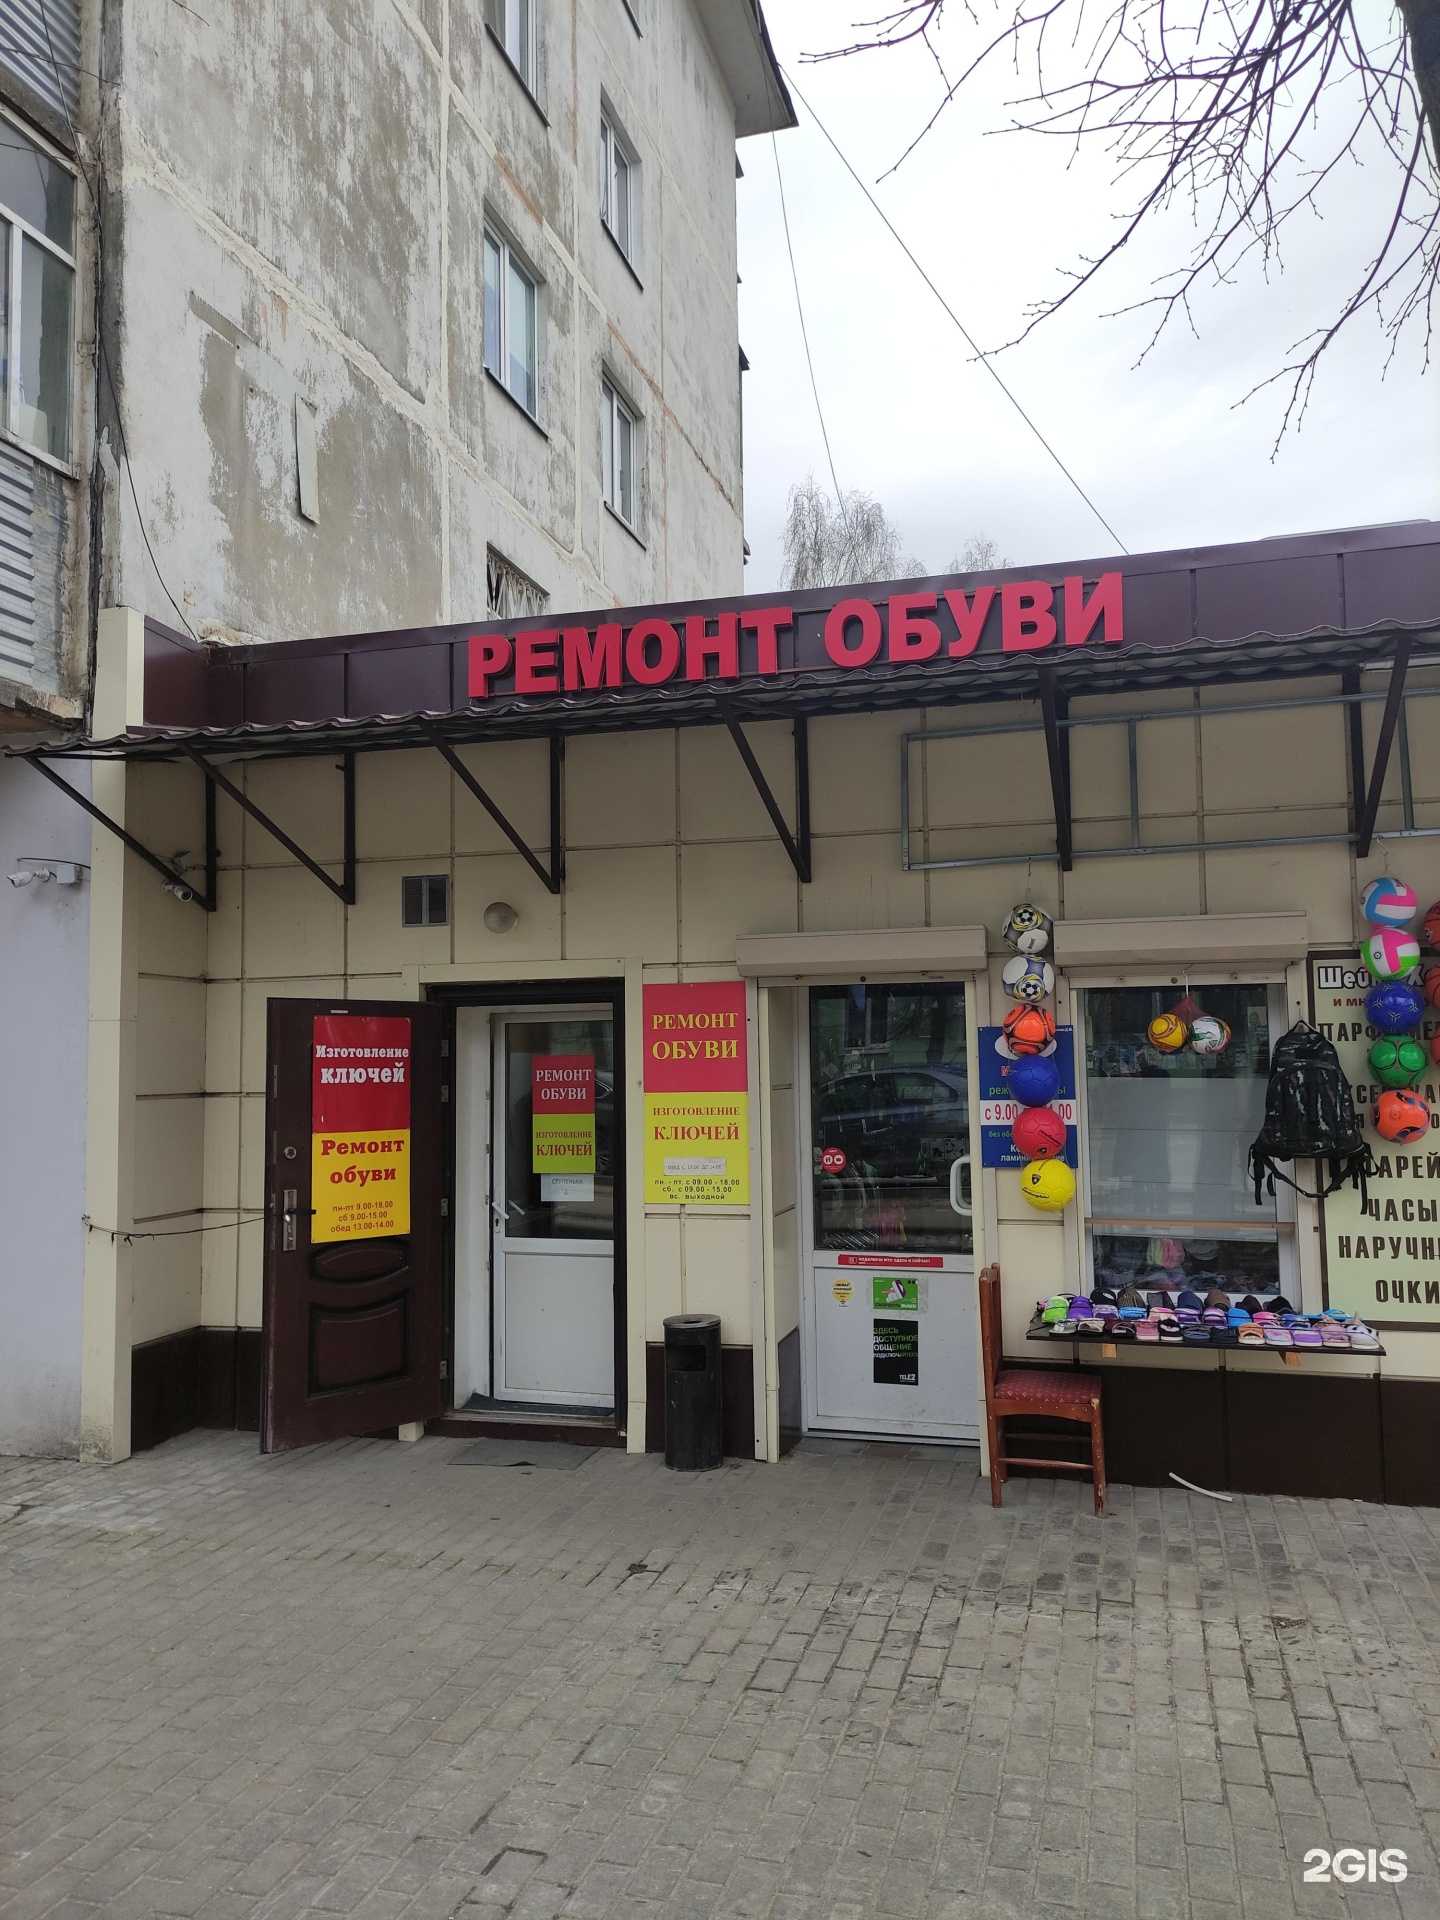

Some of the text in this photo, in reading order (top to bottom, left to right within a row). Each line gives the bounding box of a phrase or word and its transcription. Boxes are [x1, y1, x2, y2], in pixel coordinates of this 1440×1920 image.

[467, 572, 1124, 698] РЕМОНТ ОБУВИ
[651, 1012, 739, 1030] РЕМОНТ
[316, 1044, 409, 1058] Изготовление
[652, 1040, 739, 1060] ОБУВИ
[321, 1062, 405, 1084] ключей
[536, 1069, 592, 1082] РЕМОНТ
[541, 1087, 586, 1101] ОБУВИ
[653, 1106, 740, 1116] ИЗГОТОВЛЕНИЕ
[536, 1130, 592, 1139] ИЗГОТОВЛЕНИЕ
[654, 1122, 740, 1141] КЛЮЧЕЙ
[321, 1139, 404, 1156] Ремонт
[536, 1141, 592, 1156] КЛЮЧЕЙ
[330, 1165, 396, 1187] обуви
[1367, 1198, 1438, 1222] ЧАСЫ
[1338, 1235, 1440, 1260] НАРУЧН
[1375, 1279, 1440, 1304] ОЧКИ
[873, 1343, 912, 1352] ОБЩЕНИЕ
